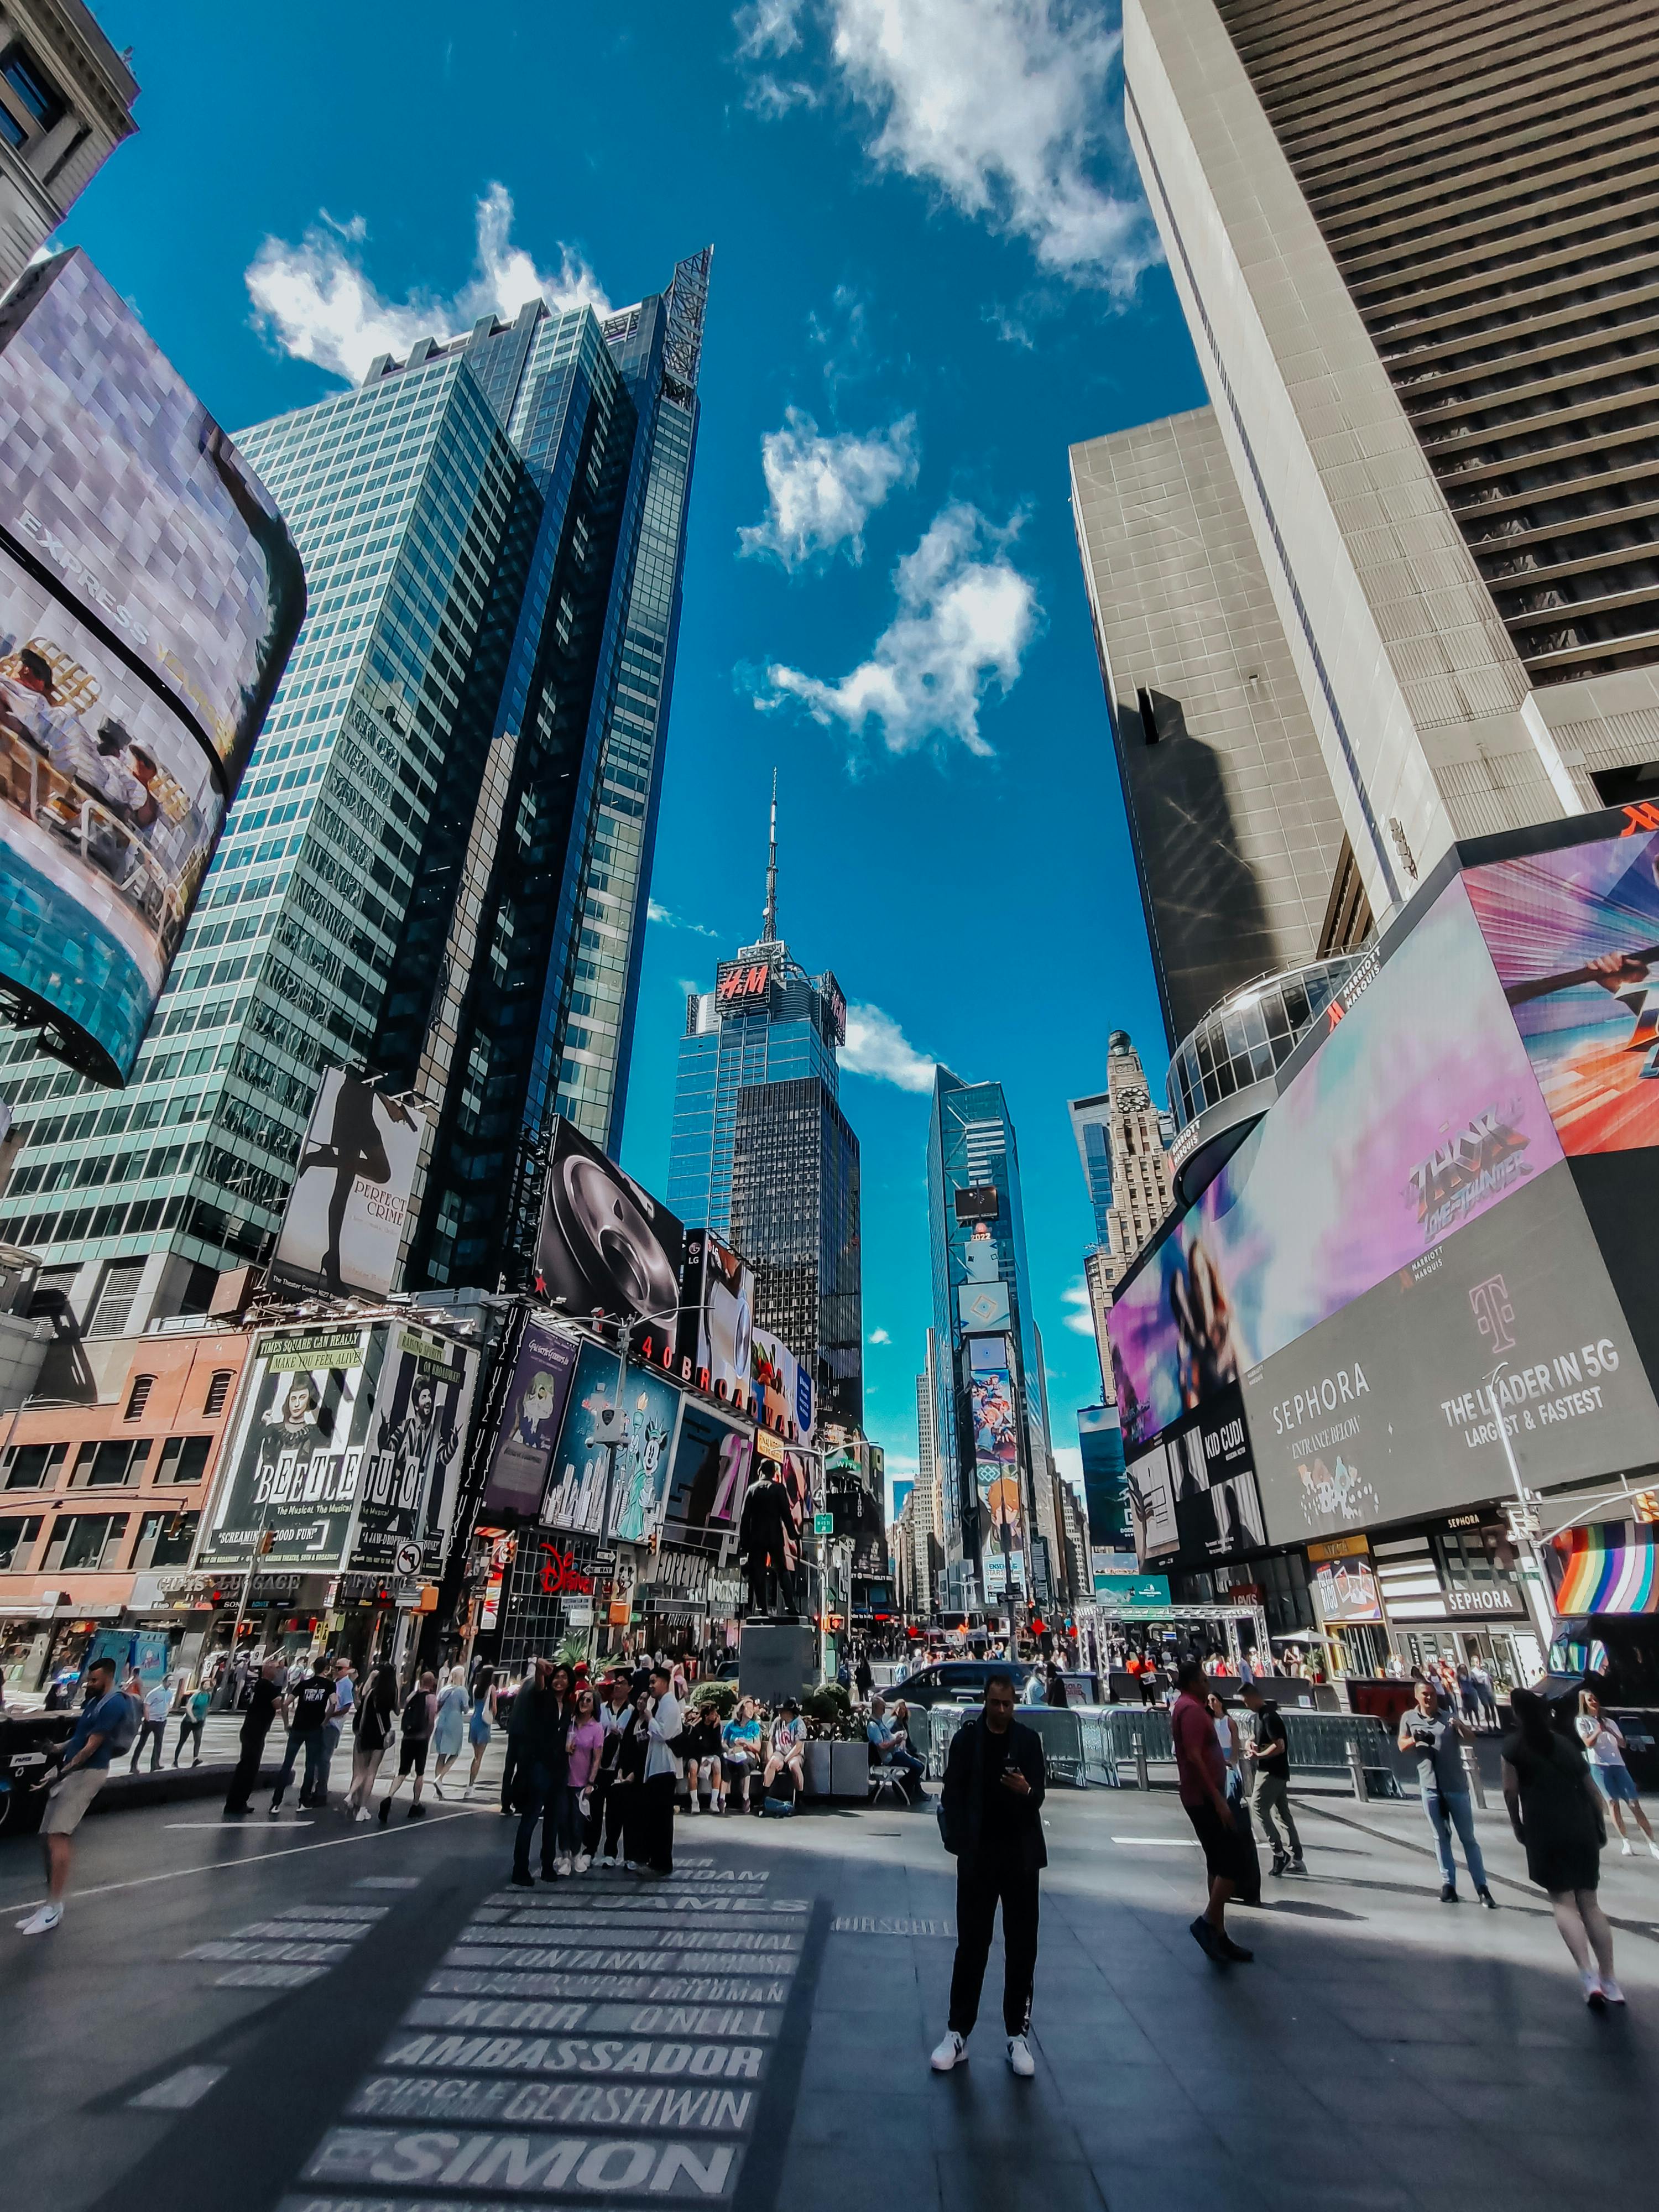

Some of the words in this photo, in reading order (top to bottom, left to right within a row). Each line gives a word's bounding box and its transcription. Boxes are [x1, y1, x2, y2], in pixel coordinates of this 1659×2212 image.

[13, 510, 150, 645] EXPRESS
[1343, 946, 1381, 998] MARRIOTT
[1345, 963, 1381, 1009] MARQUIS
[1171, 1119, 1201, 1156] MARRIOTT
[1173, 1133, 1199, 1166] MARQUIS
[354, 1180, 408, 1213] PERFECT
[367, 1201, 404, 1227] CRIME
[688, 1256, 699, 1265] LG
[1411, 1245, 1444, 1271] MARRIOTT
[1415, 1258, 1444, 1282] MARQUIS
[273, 1275, 283, 1284] The
[283, 1279, 301, 1290] Theater
[260, 1341, 283, 1355] TIMES
[283, 1336, 312, 1353] SQUARE
[313, 1335, 330, 1350] CAN
[330, 1332, 359, 1347] REALLY
[401, 1335, 423, 1353] RAISING
[424, 1345, 443, 1361] SPIRITS
[273, 1357, 296, 1369] MAKE
[298, 1354, 314, 1368] YOU
[315, 1353, 333, 1366] FEEL
[336, 1352, 362, 1365] ALIVE!
[423, 1361, 432, 1373] ON
[1272, 1362, 1371, 1435] SEPHORA
[1441, 1392, 1478, 1427] THE
[1553, 1352, 1583, 1388] IN
[1581, 1338, 1620, 1378] 5G
[1522, 1409, 1537, 1431] &
[1538, 1385, 1604, 1426] FASTEST
[1204, 1431, 1221, 1460] KID
[1220, 1417, 1245, 1452] CUDI
[1291, 1426, 1330, 1459] ENTRANCE
[1330, 1416, 1360, 1443] BELOW
[253, 1446, 364, 1504] BEETLE
[837, 1460, 857, 1470] WITH
[277, 1506, 288, 1515] The
[316, 1504, 328, 1514] The
[1448, 1514, 1480, 1528] SEPHORA
[156, 1575, 205, 1592] GIFTS
[655, 1551, 709, 1589] FOREVER
[1448, 1589, 1513, 1611] SEPHORA
[591, 1896, 809, 1912] JAMES
[495, 1948, 676, 1971] FONTANNE
[447, 2001, 588, 2030] KERR
[629, 2007, 770, 2036] O'NEILL
[382, 2034, 763, 2078] AMBASSADOR
[363, 2077, 507, 2100] CIRCLE
[502, 2083, 753, 2129] GERSHWIN
[368, 2132, 738, 2195] SIMON
